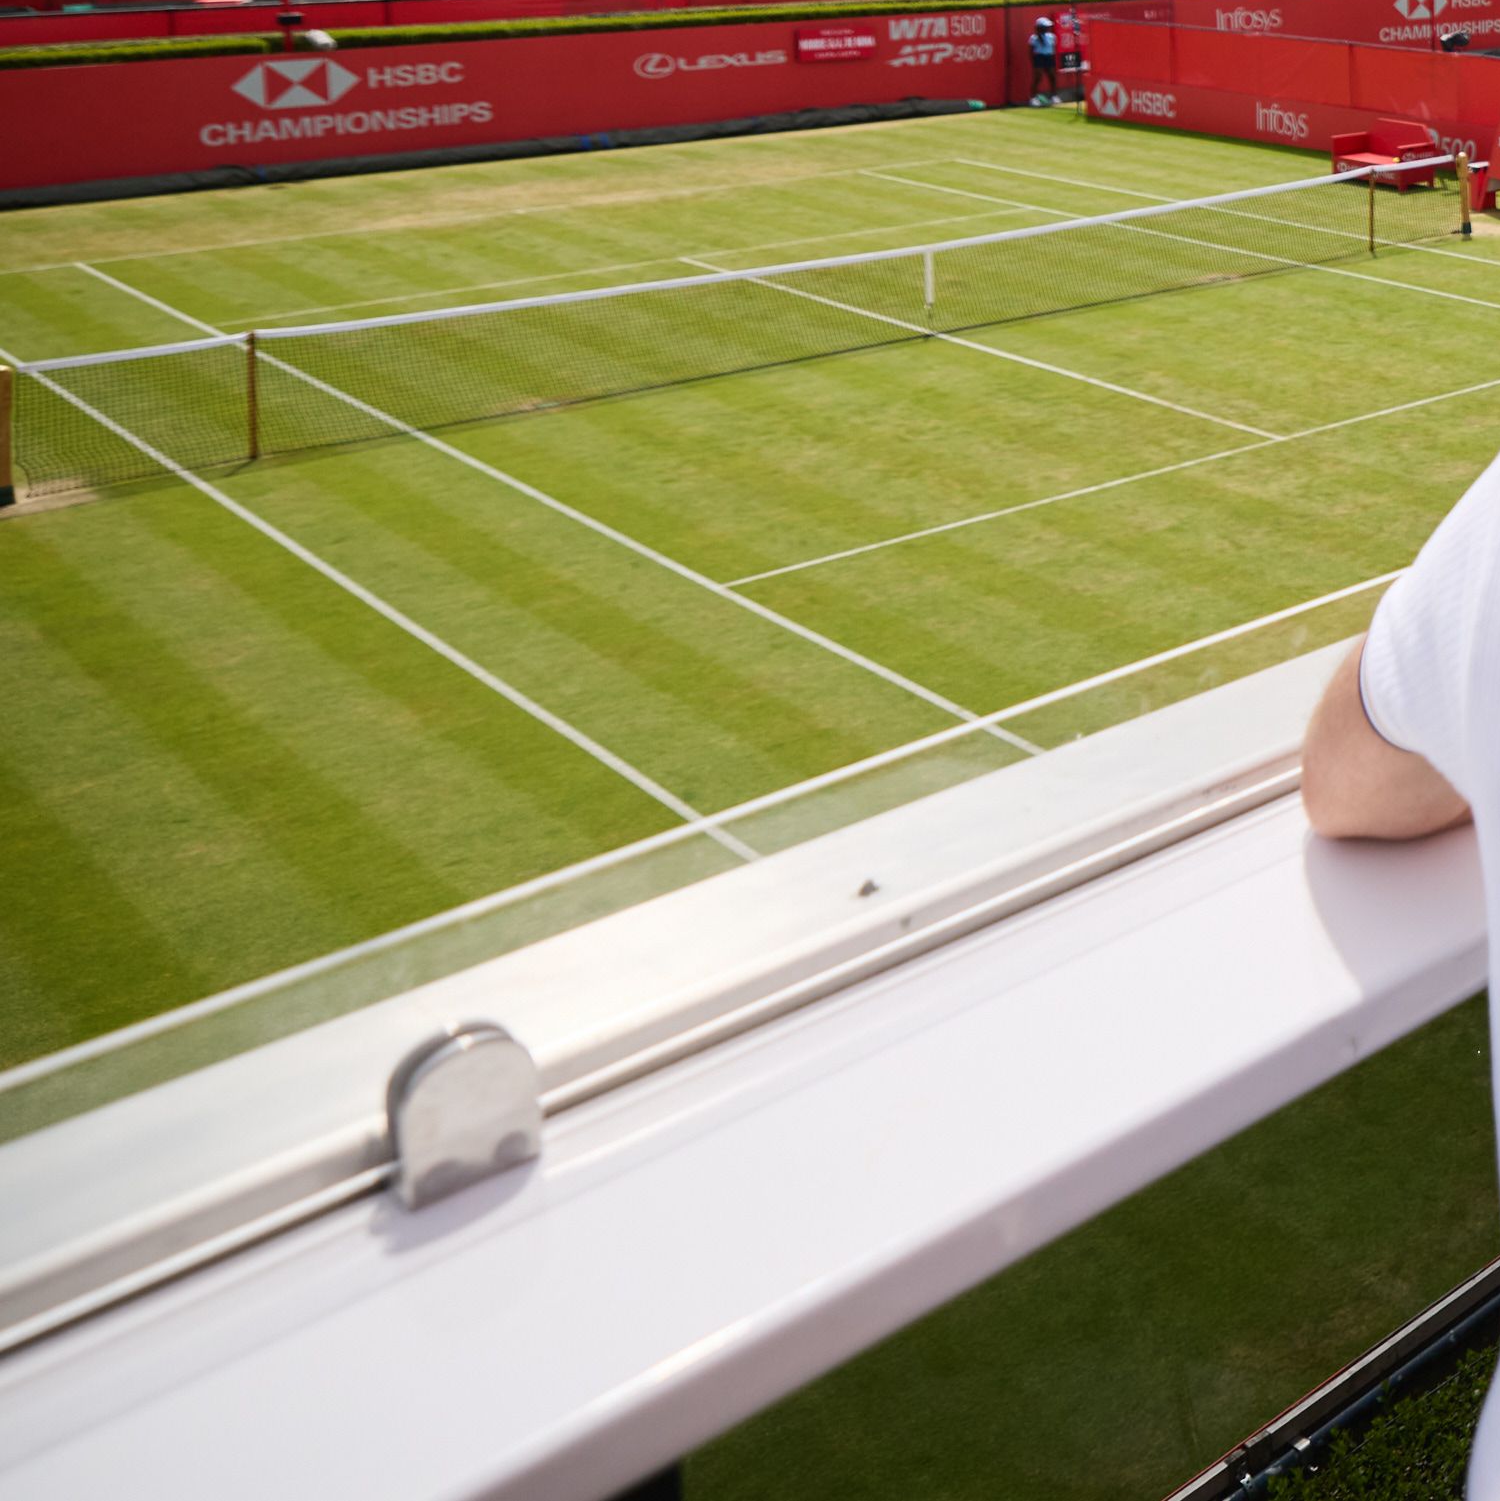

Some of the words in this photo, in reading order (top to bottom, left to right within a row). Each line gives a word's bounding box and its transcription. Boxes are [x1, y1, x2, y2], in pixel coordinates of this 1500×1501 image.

[888, 18, 948, 40] WTA
[950, 15, 986, 36] 500
[1215, 7, 1284, 31] Infosys
[676, 50, 788, 71] LEXUS
[886, 43, 954, 67] ATP
[366, 61, 465, 89] HSBC
[1131, 90, 1177, 118] HSBC
[199, 101, 494, 147] CHAMPIONSHIPS
[1255, 100, 1310, 141] Infosys
